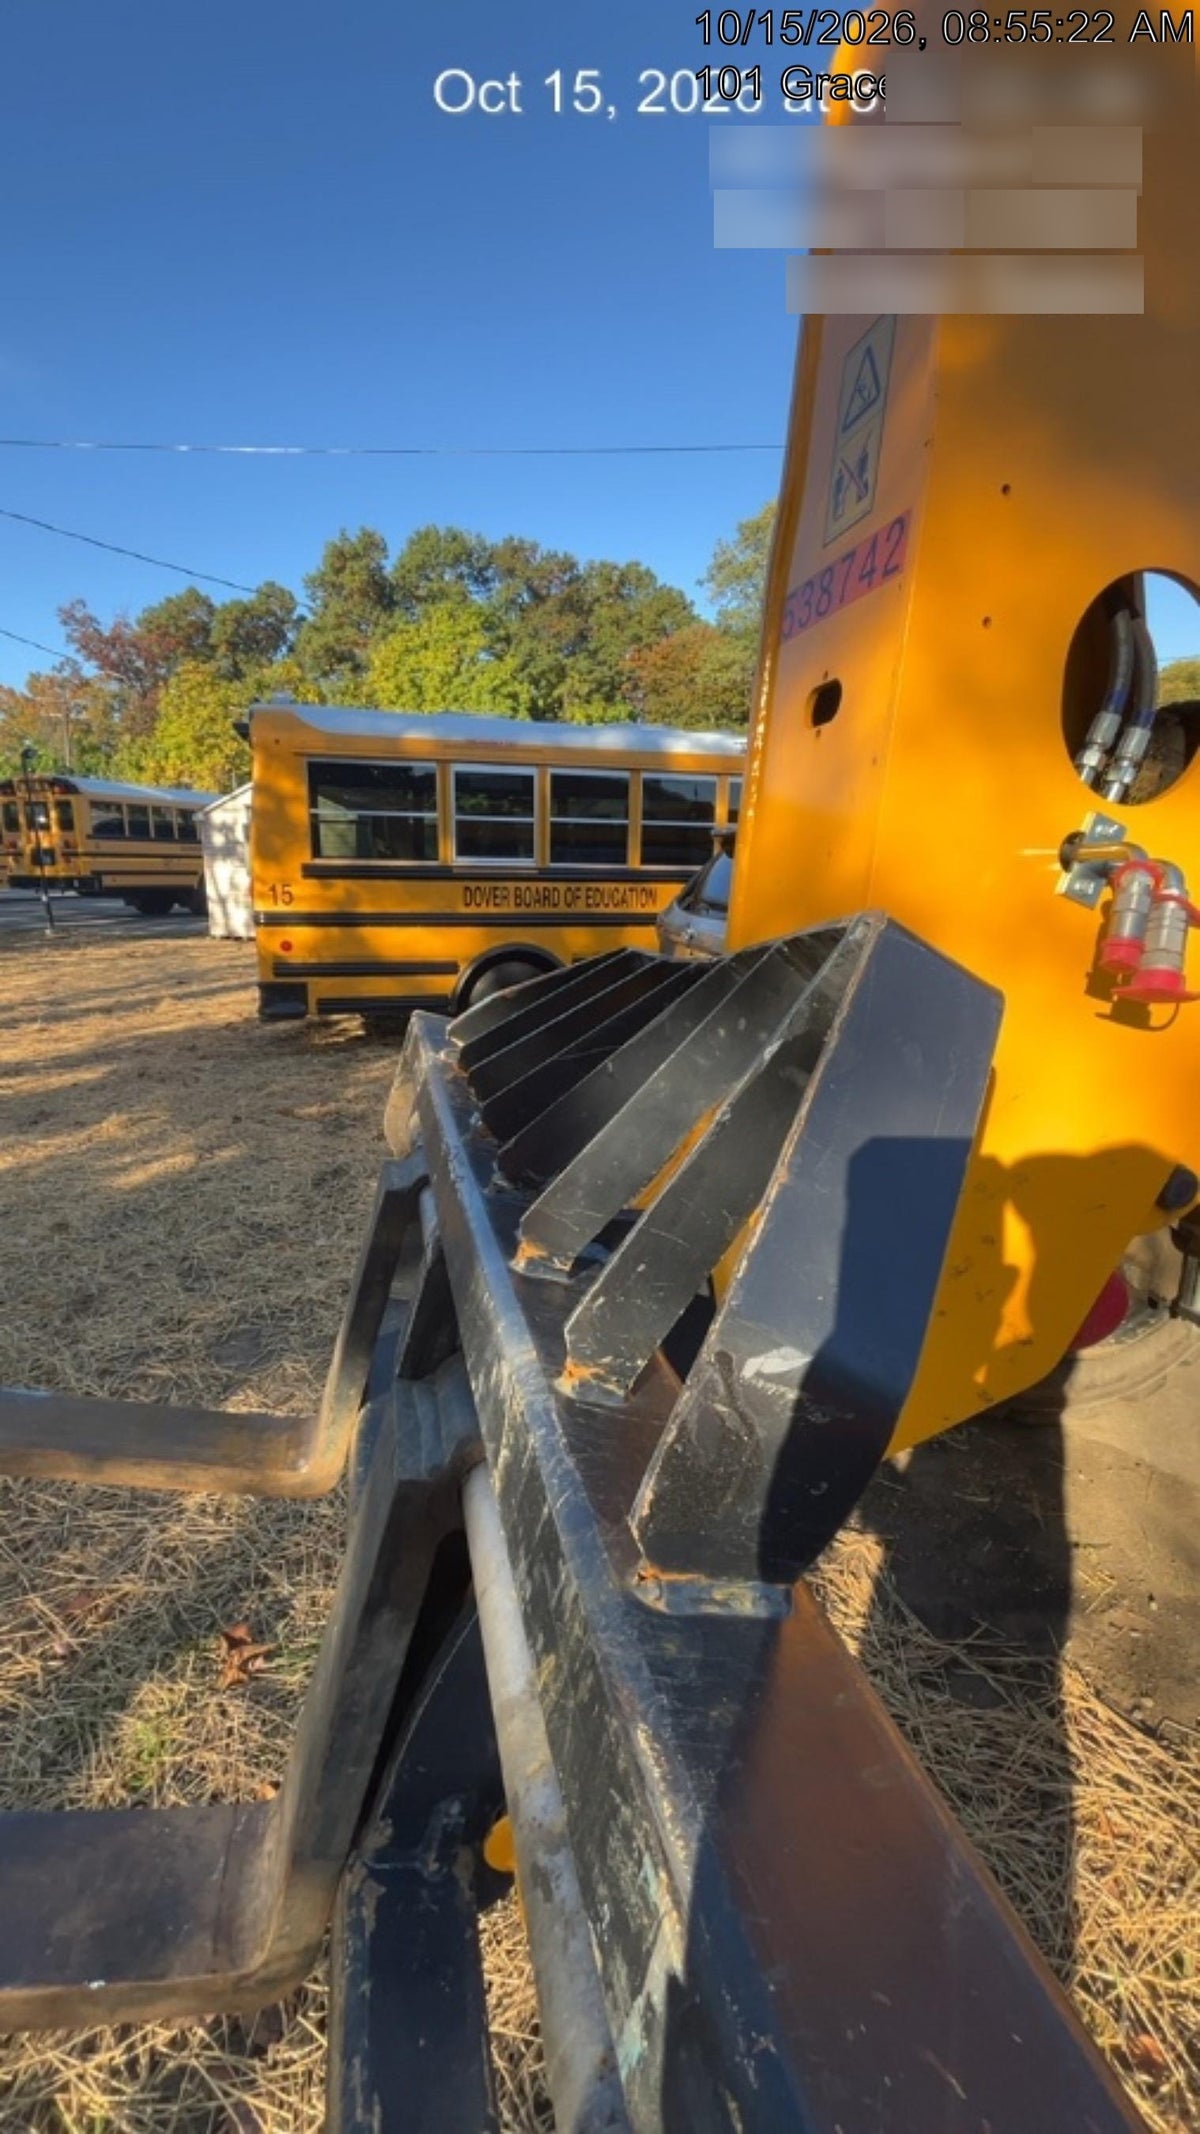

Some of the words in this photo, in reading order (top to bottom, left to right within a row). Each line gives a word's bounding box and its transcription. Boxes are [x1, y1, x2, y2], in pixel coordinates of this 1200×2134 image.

[782, 515, 906, 641] 538742
[268, 883, 295, 906] 15
[463, 886, 509, 908] DOVER
[514, 886, 560, 909] BOARD
[564, 886, 582, 908] OF
[586, 886, 658, 909] EDUCATION
